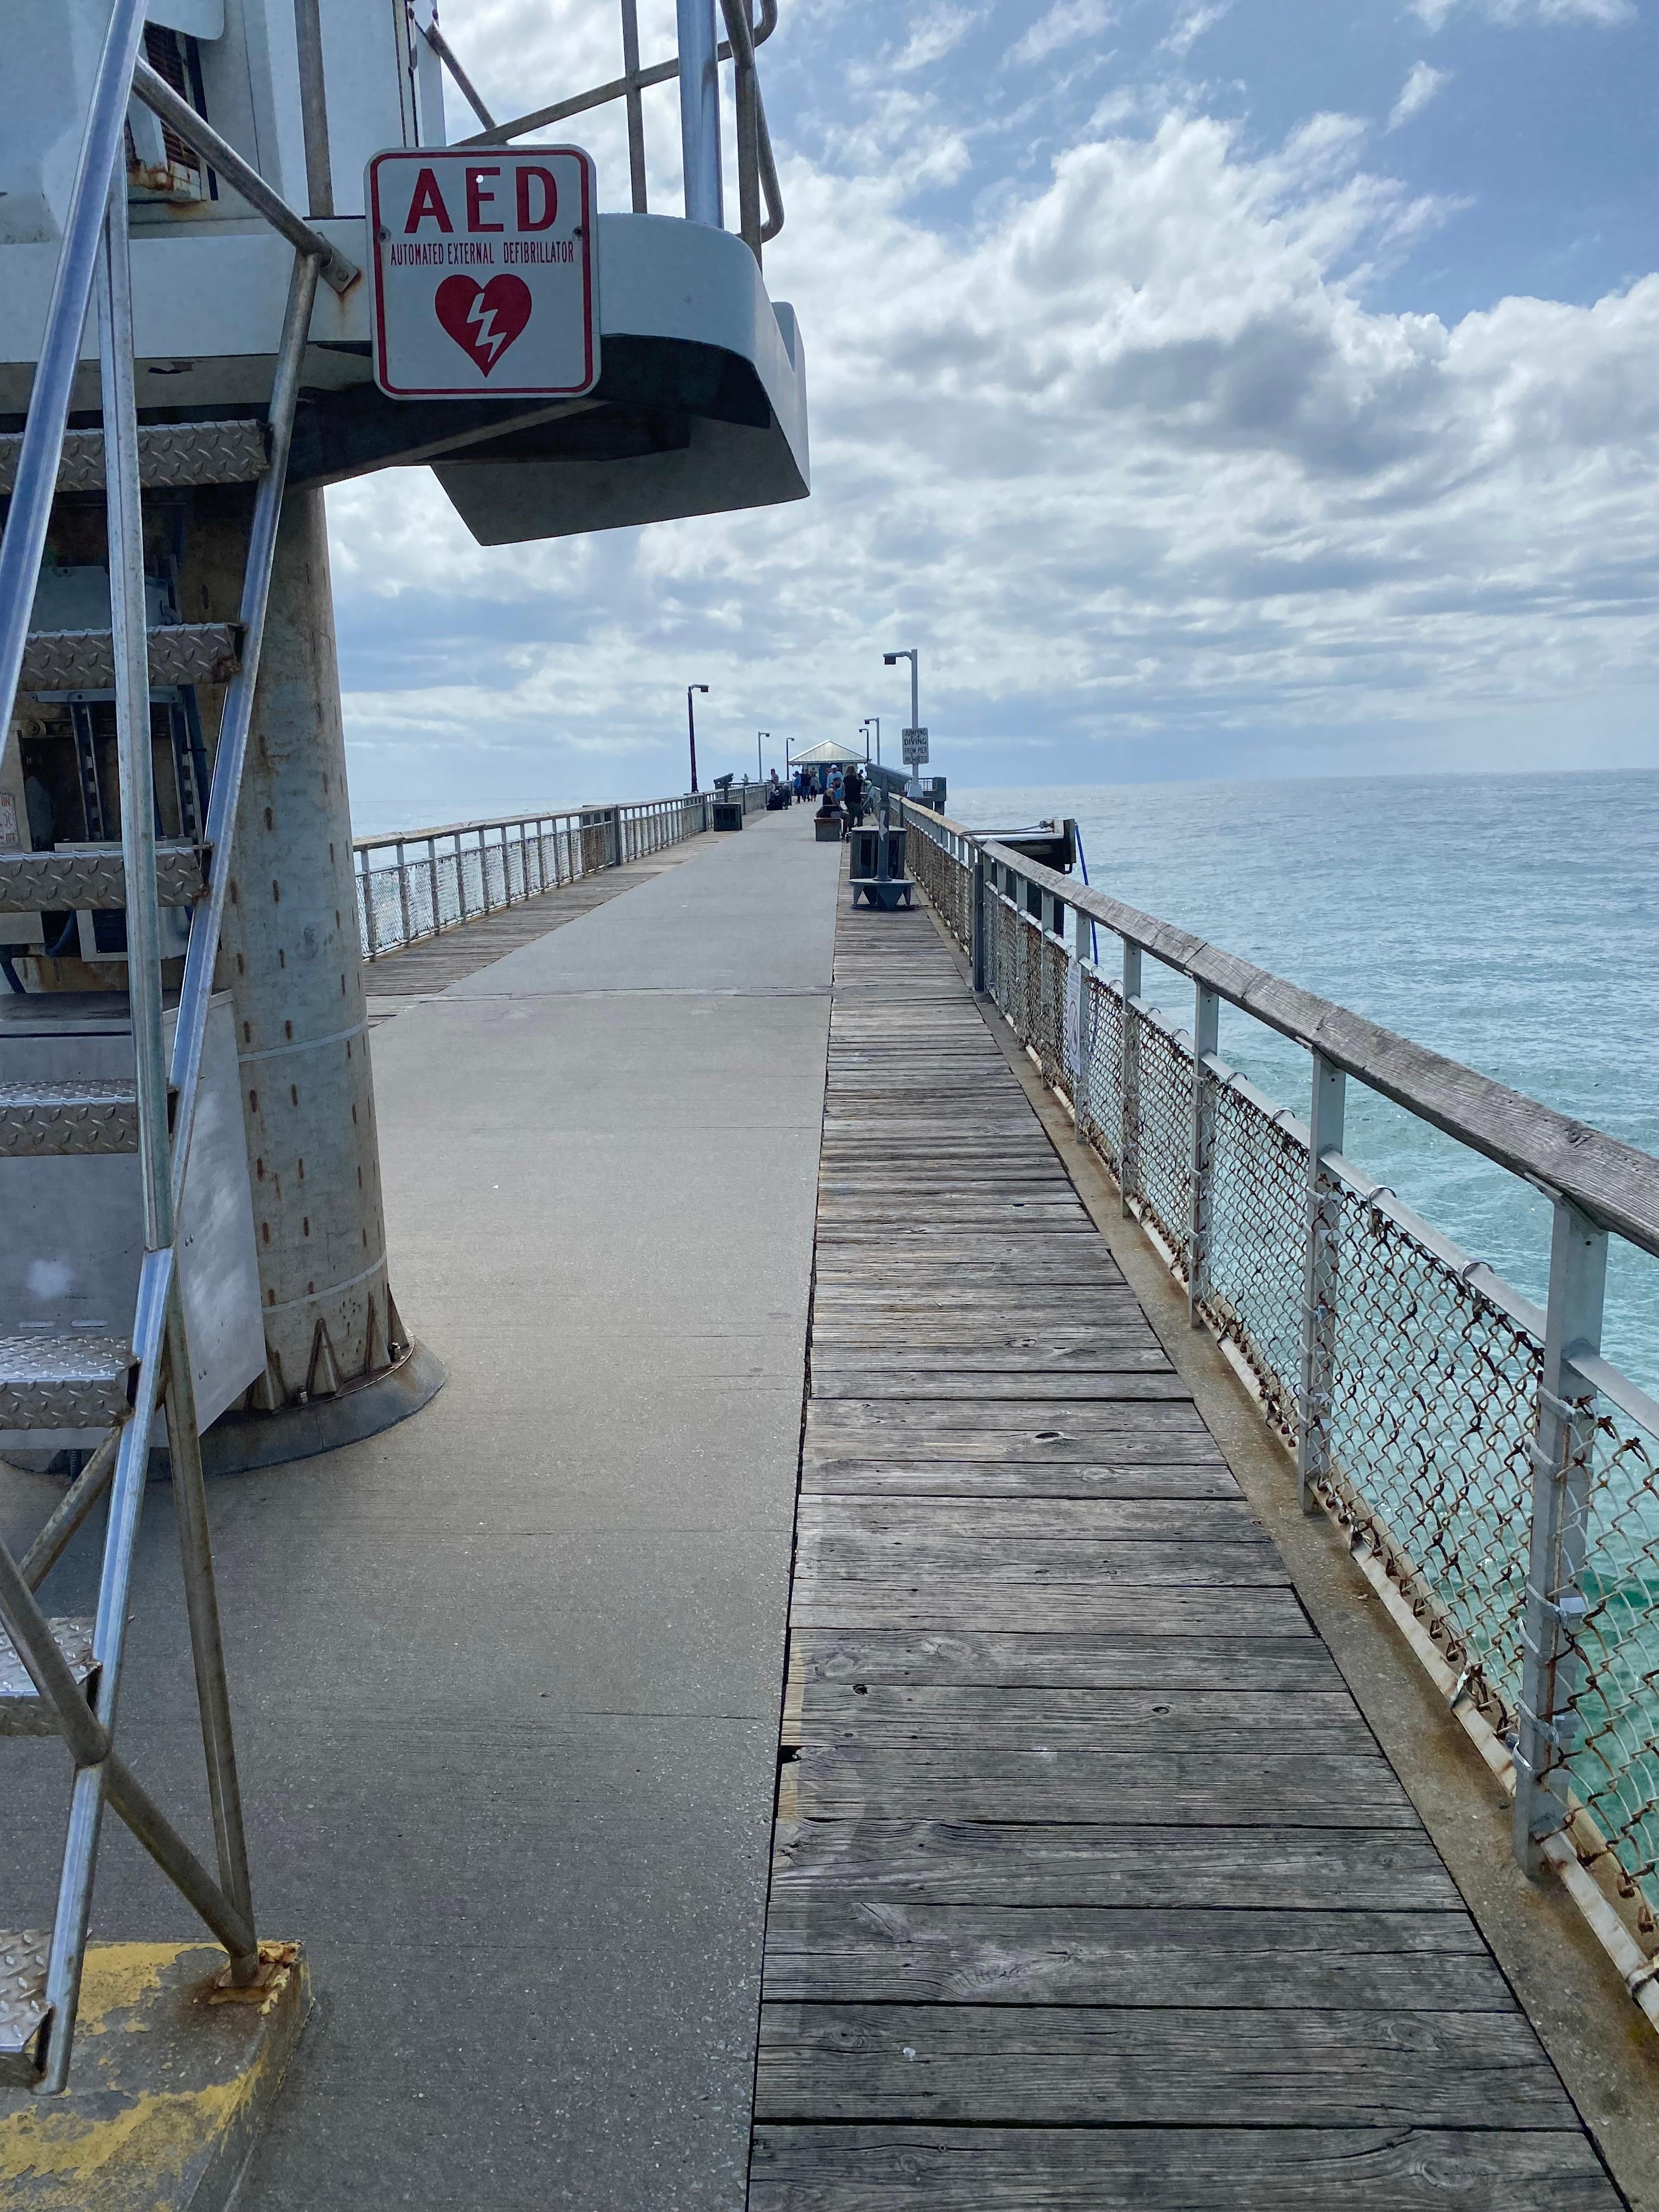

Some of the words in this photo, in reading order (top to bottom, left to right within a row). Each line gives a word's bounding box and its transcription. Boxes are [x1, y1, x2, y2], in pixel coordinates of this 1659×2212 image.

[404, 166, 558, 233] AED
[391, 242, 444, 266] AUTOMATED
[448, 242, 495, 265] EXTERNAL
[503, 241, 574, 263] DEFIBRILLATOR
